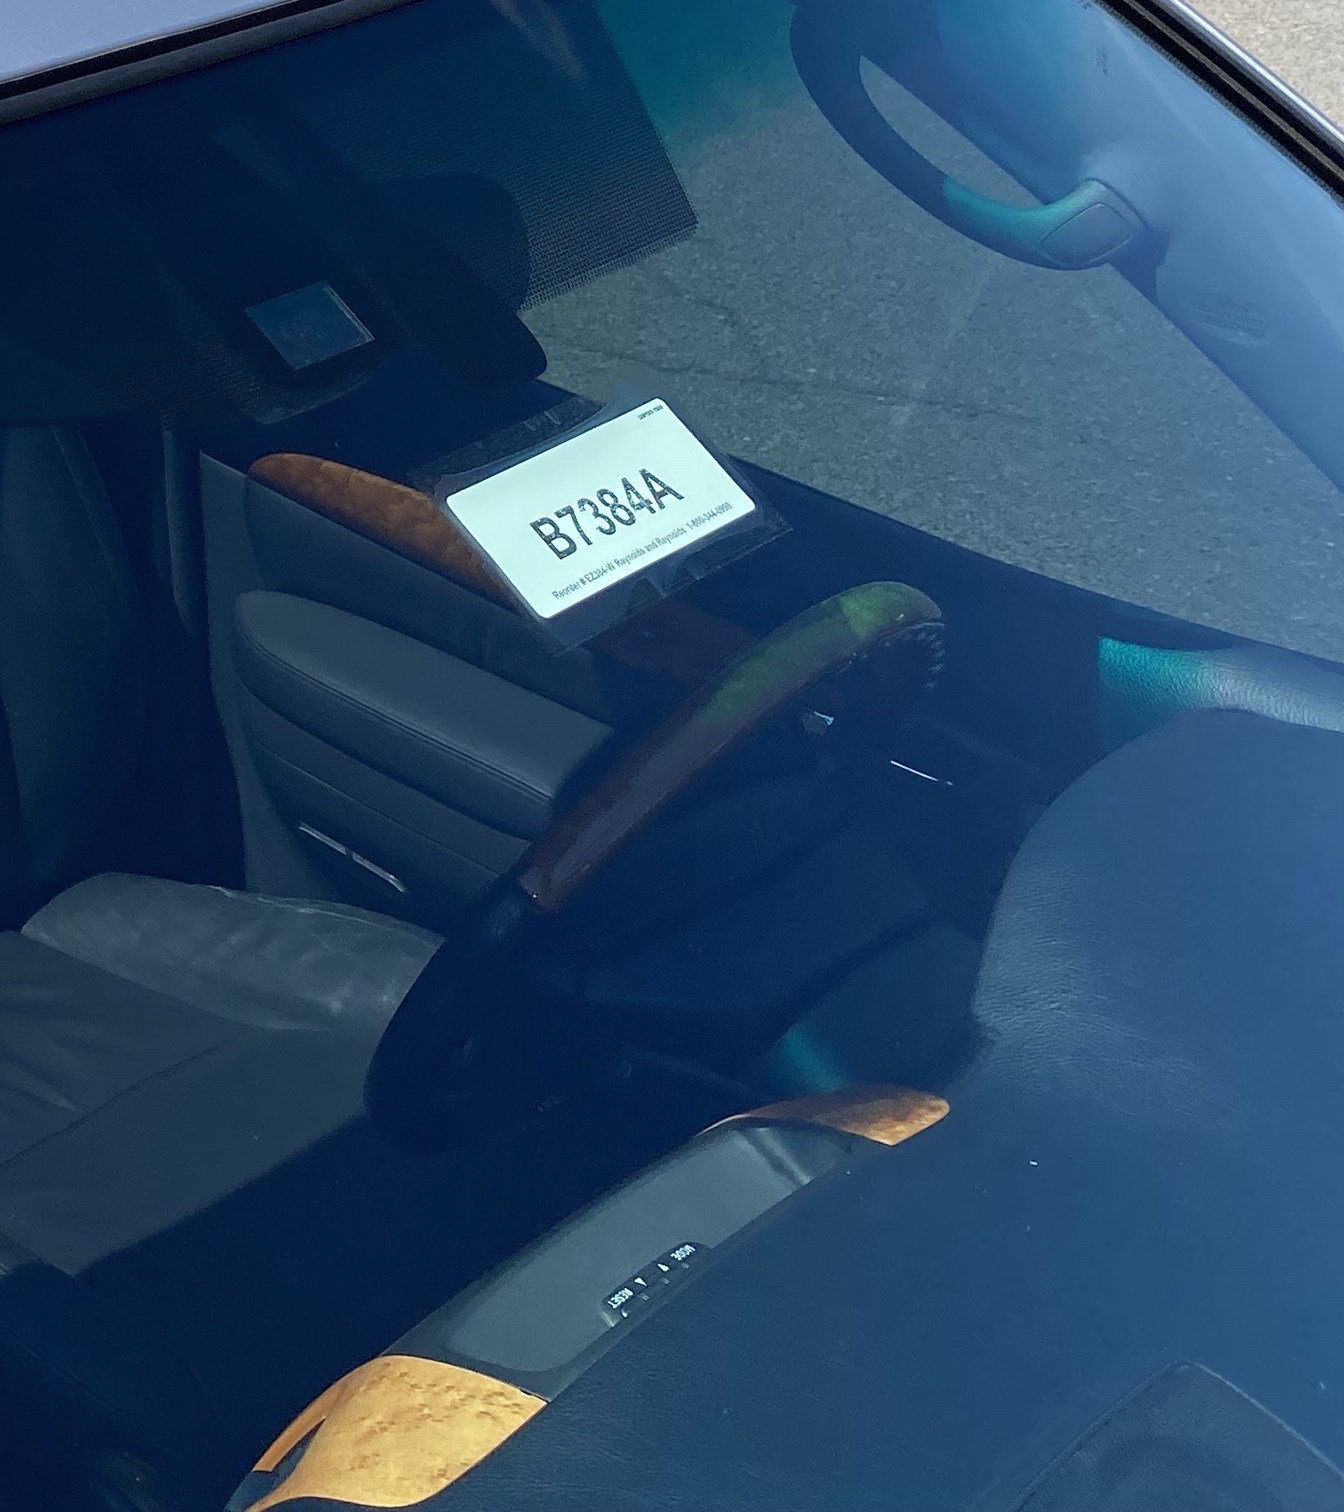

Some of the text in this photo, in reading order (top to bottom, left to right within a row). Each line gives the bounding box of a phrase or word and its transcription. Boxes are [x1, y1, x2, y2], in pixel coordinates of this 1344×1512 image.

[530, 468, 685, 560] B7384A
[551, 580, 582, 600] Reorder
[645, 540, 657, 554] and
[607, 1287, 634, 1309] RESET
